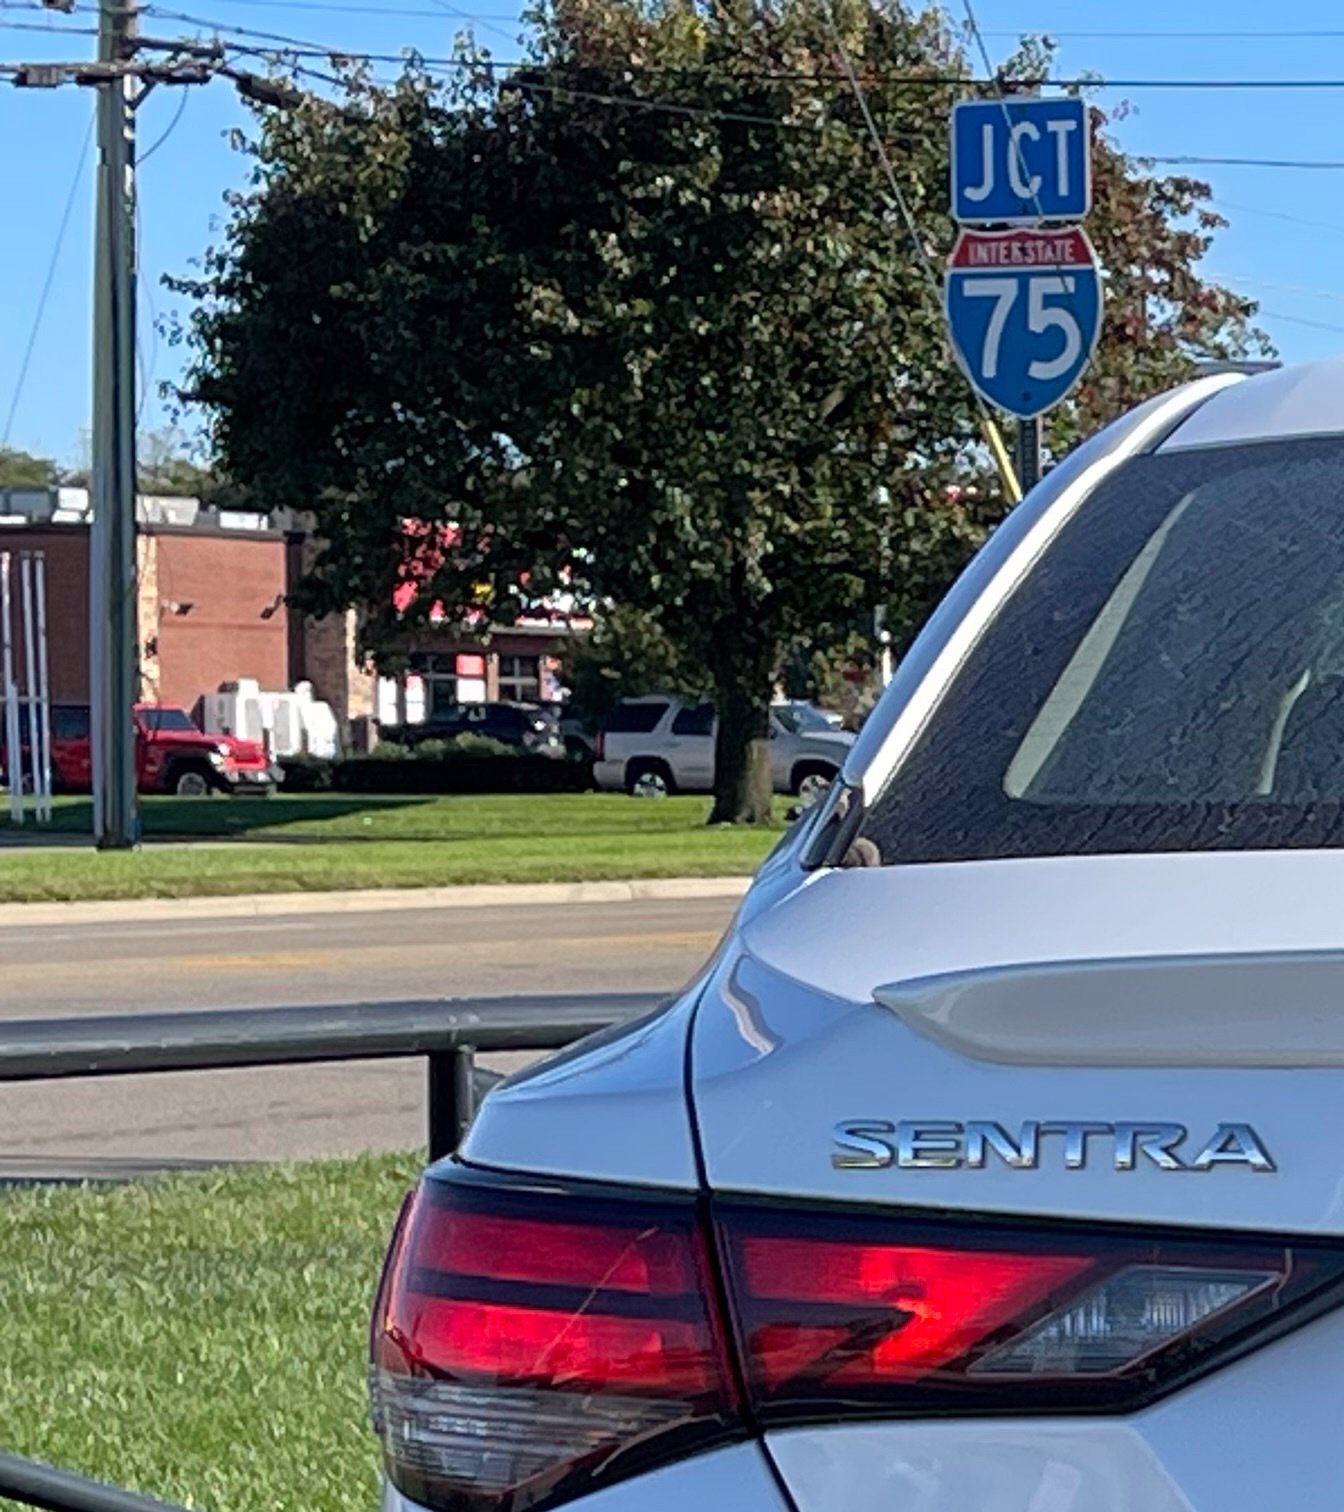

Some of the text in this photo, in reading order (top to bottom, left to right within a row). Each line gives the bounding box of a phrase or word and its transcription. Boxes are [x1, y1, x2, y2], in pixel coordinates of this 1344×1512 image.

[963, 120, 1077, 201] JCT
[967, 242, 1076, 265] INTERSTATE
[962, 278, 1082, 381] 75
[831, 1119, 1277, 1173] SENTRA
